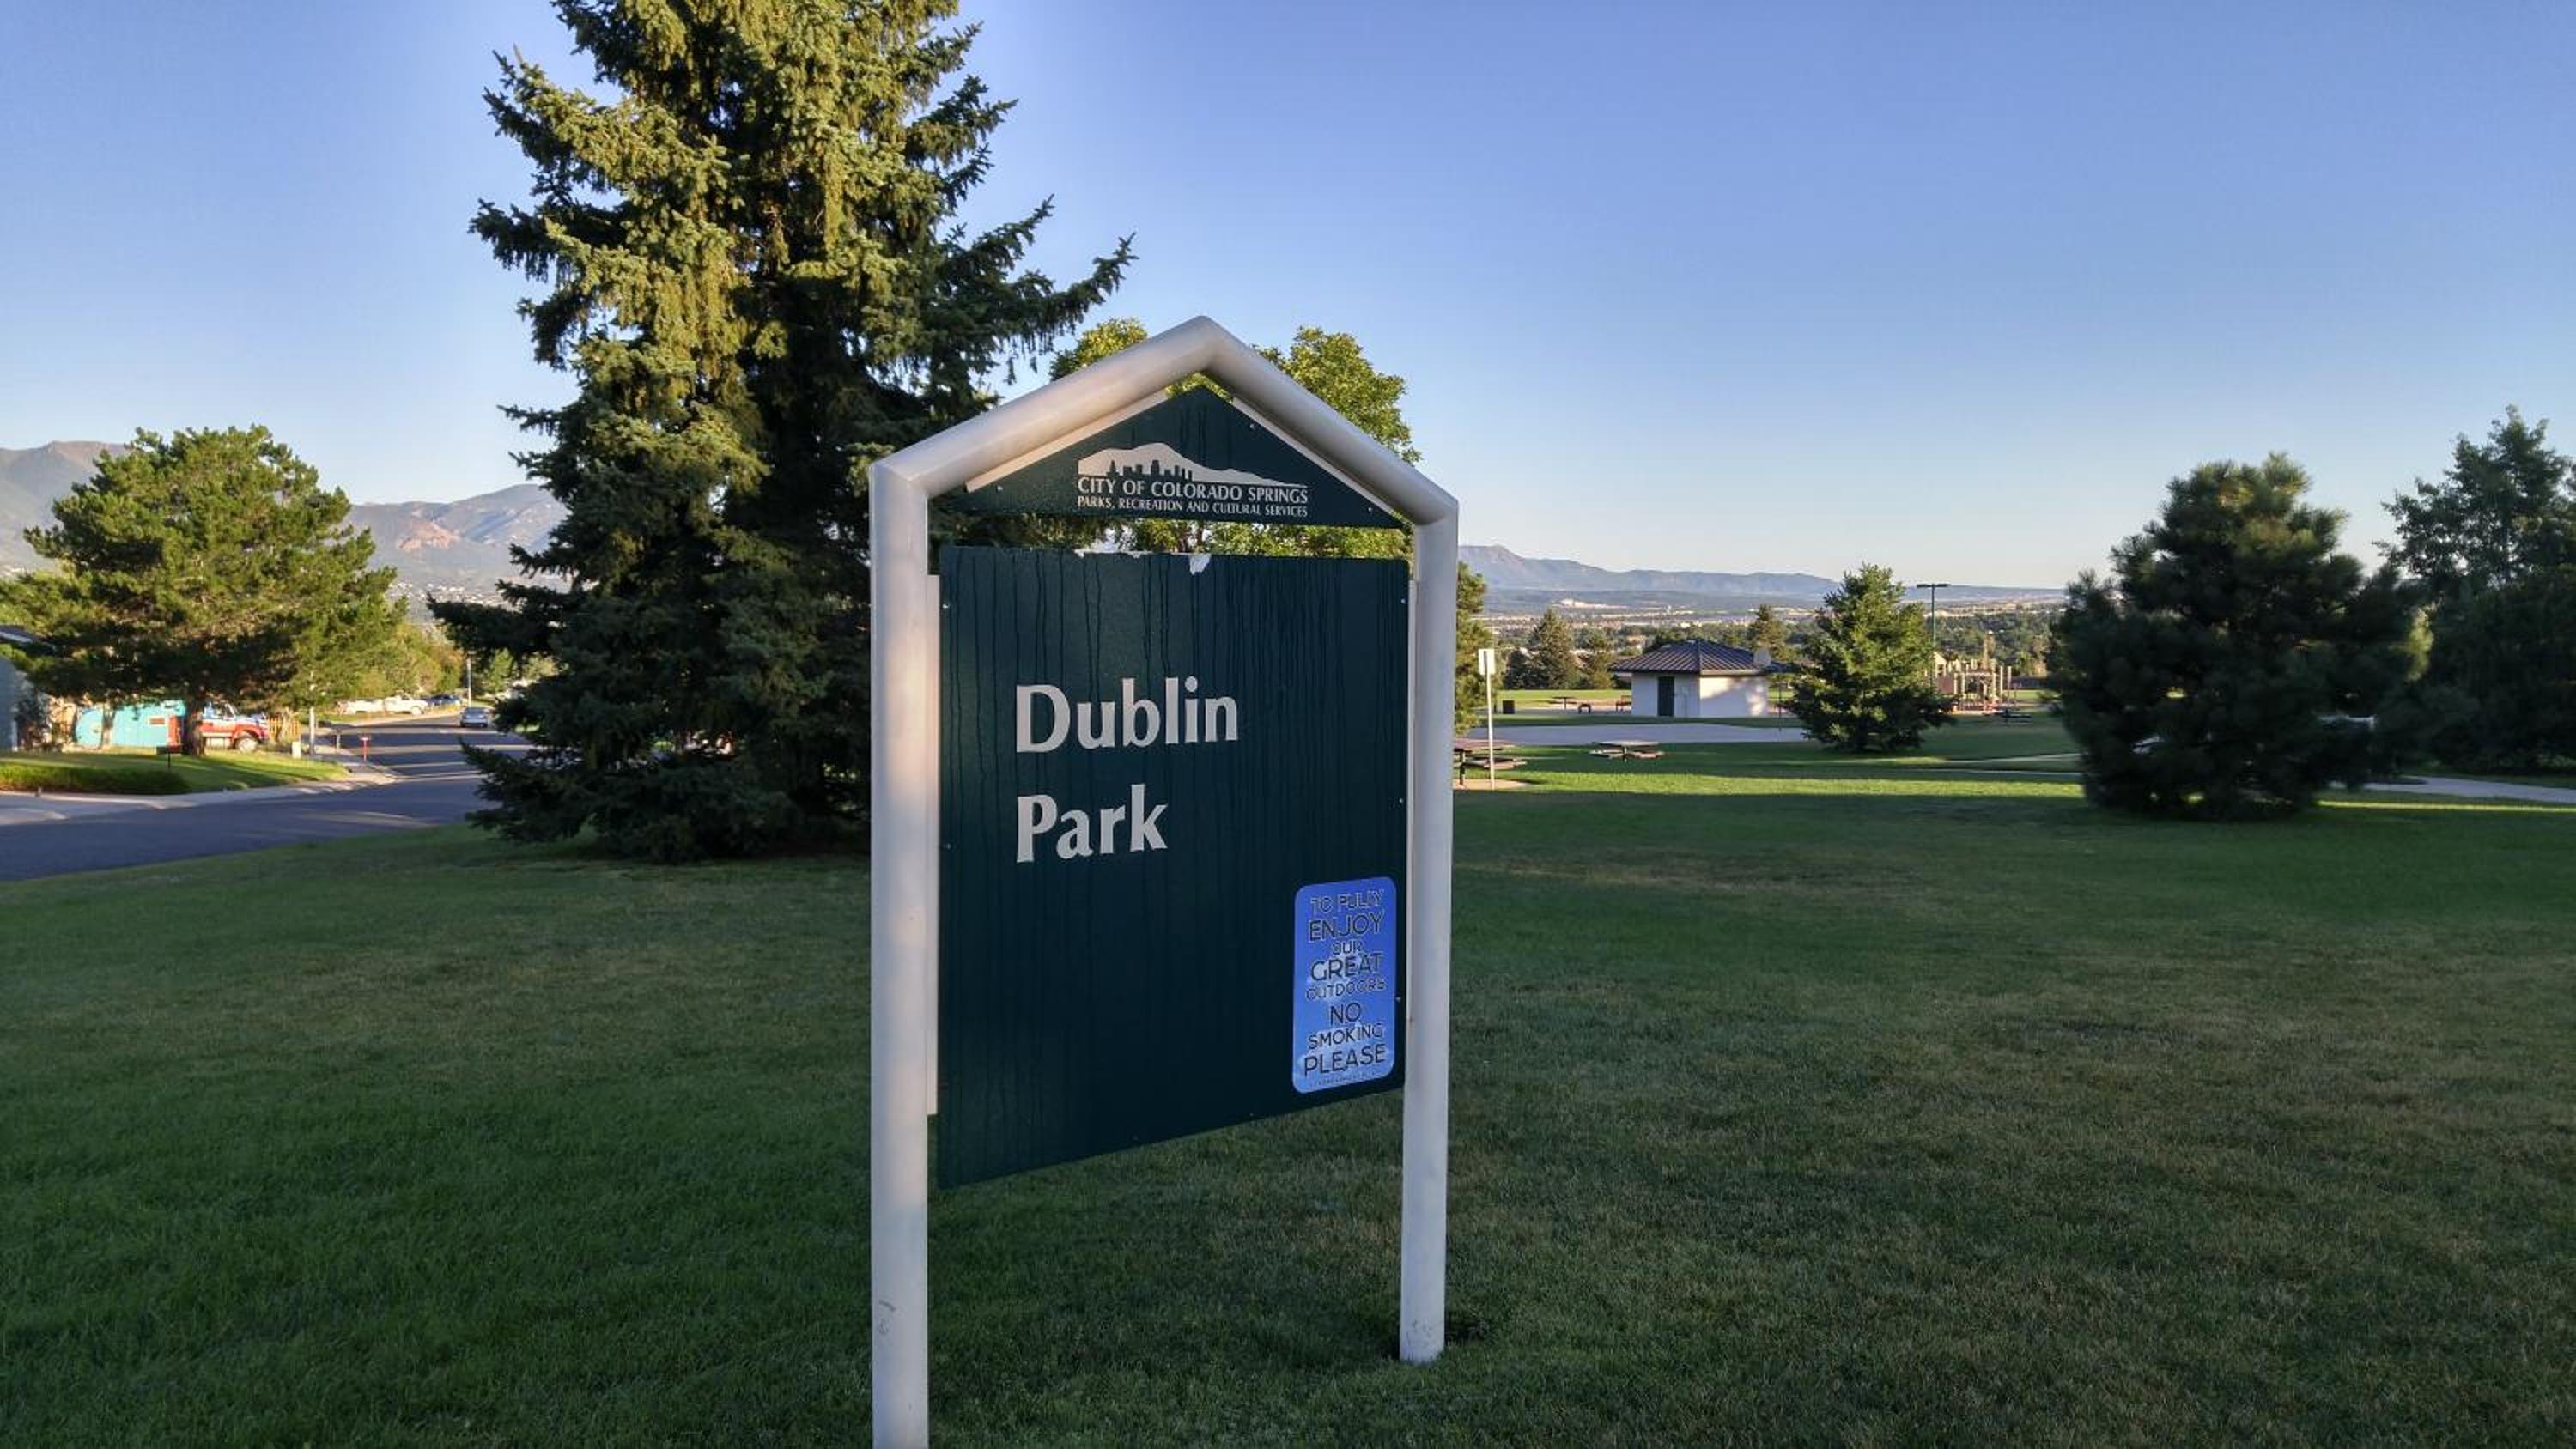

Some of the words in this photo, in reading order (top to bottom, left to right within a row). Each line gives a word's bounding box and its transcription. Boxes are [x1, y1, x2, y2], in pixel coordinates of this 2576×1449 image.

[1078, 476, 1115, 495] CITY
[1122, 480, 1145, 495] OF
[1151, 482, 1242, 501] COLORADO
[1248, 487, 1309, 505] SPRINGS
[1078, 495, 1115, 509] PARKS,
[1119, 497, 1183, 512] RECREATION
[1187, 501, 1210, 513] AND
[1212, 503, 1261, 515] CULTURAL
[1265, 505, 1308, 518] SERVICES
[1016, 676, 1237, 753] Dublin
[1016, 783, 1169, 864] Park
[1310, 897, 1333, 914] TO
[1337, 889, 1385, 911] FULLY
[1309, 911, 1383, 942] ENJOY
[1332, 942, 1364, 956] OUR
[1311, 953, 1383, 981] GREAT
[1306, 978, 1387, 1001] OUTDOORS
[1330, 1002, 1362, 1026] NO
[1308, 1023, 1384, 1051] SMOKING
[1304, 1044, 1387, 1077] PLEASE
